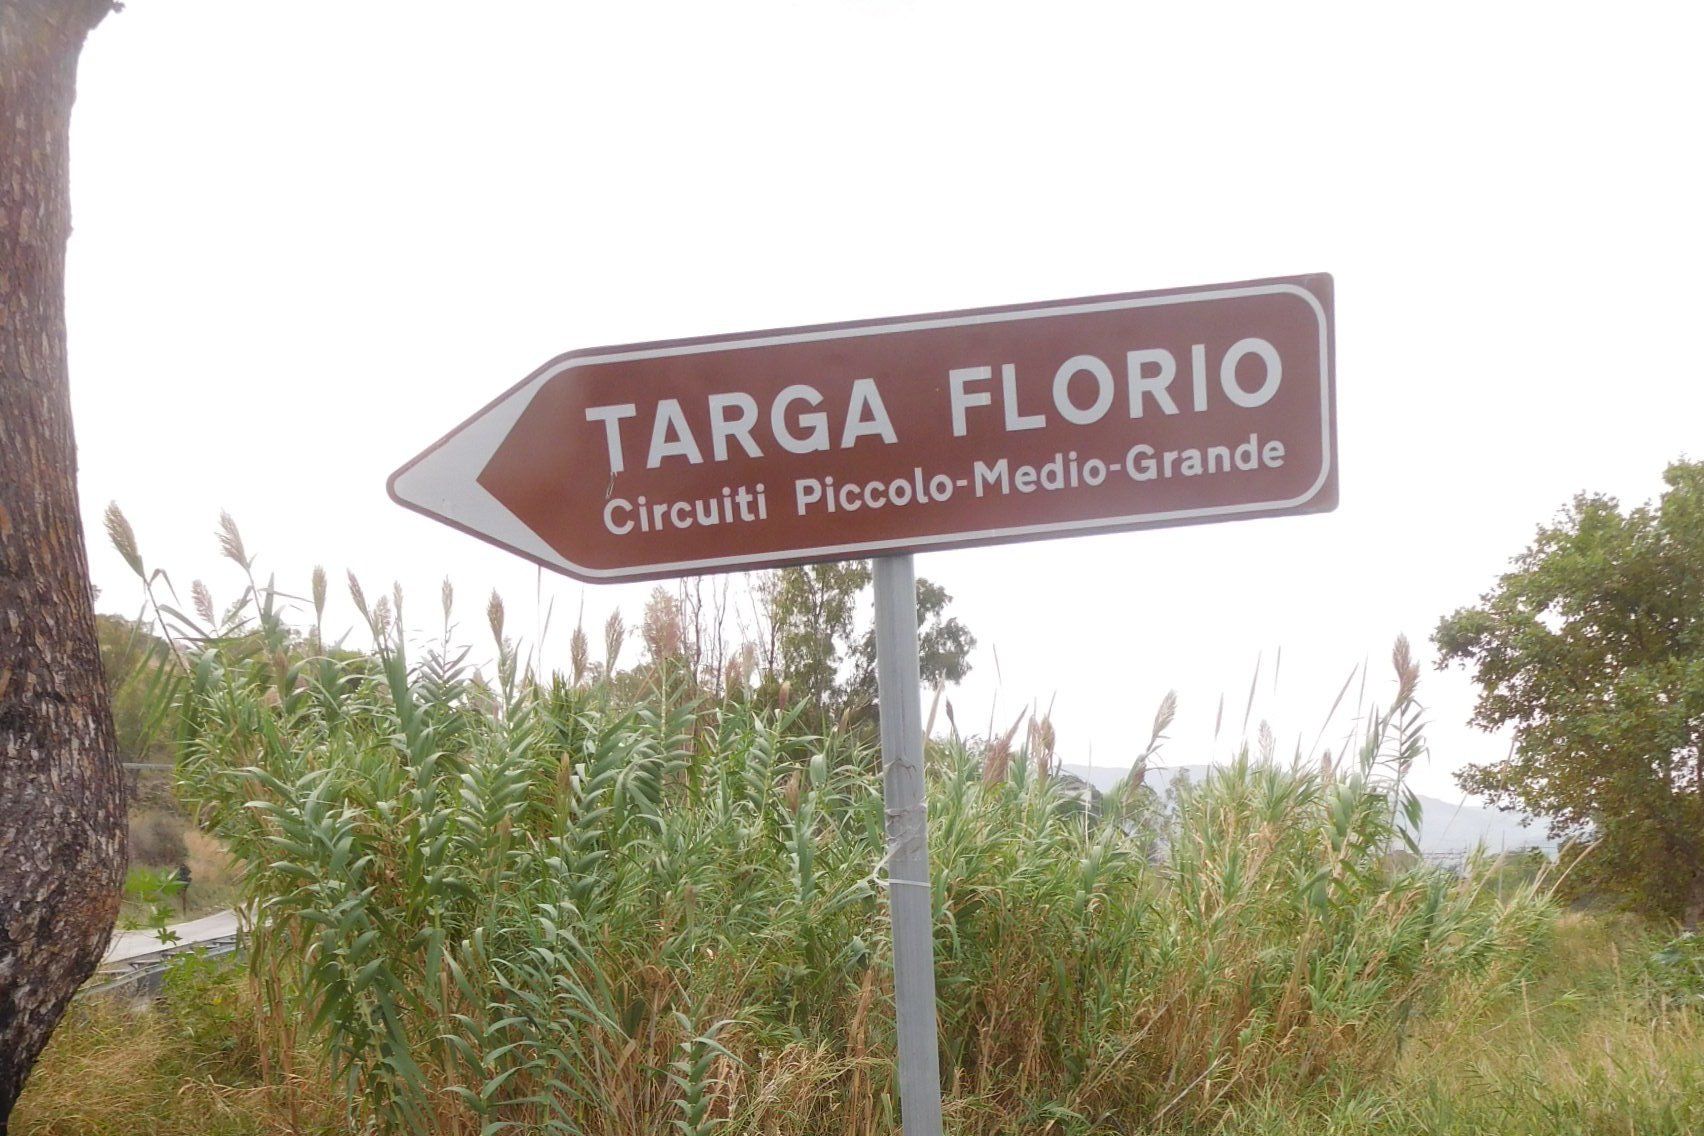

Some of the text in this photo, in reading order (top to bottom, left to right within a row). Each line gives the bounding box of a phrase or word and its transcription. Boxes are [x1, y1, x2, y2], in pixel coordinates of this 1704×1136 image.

[585, 337, 1283, 473] TARGA FLORIO
[603, 433, 1286, 535] Circuiti Piccolo-Medio-Grande
